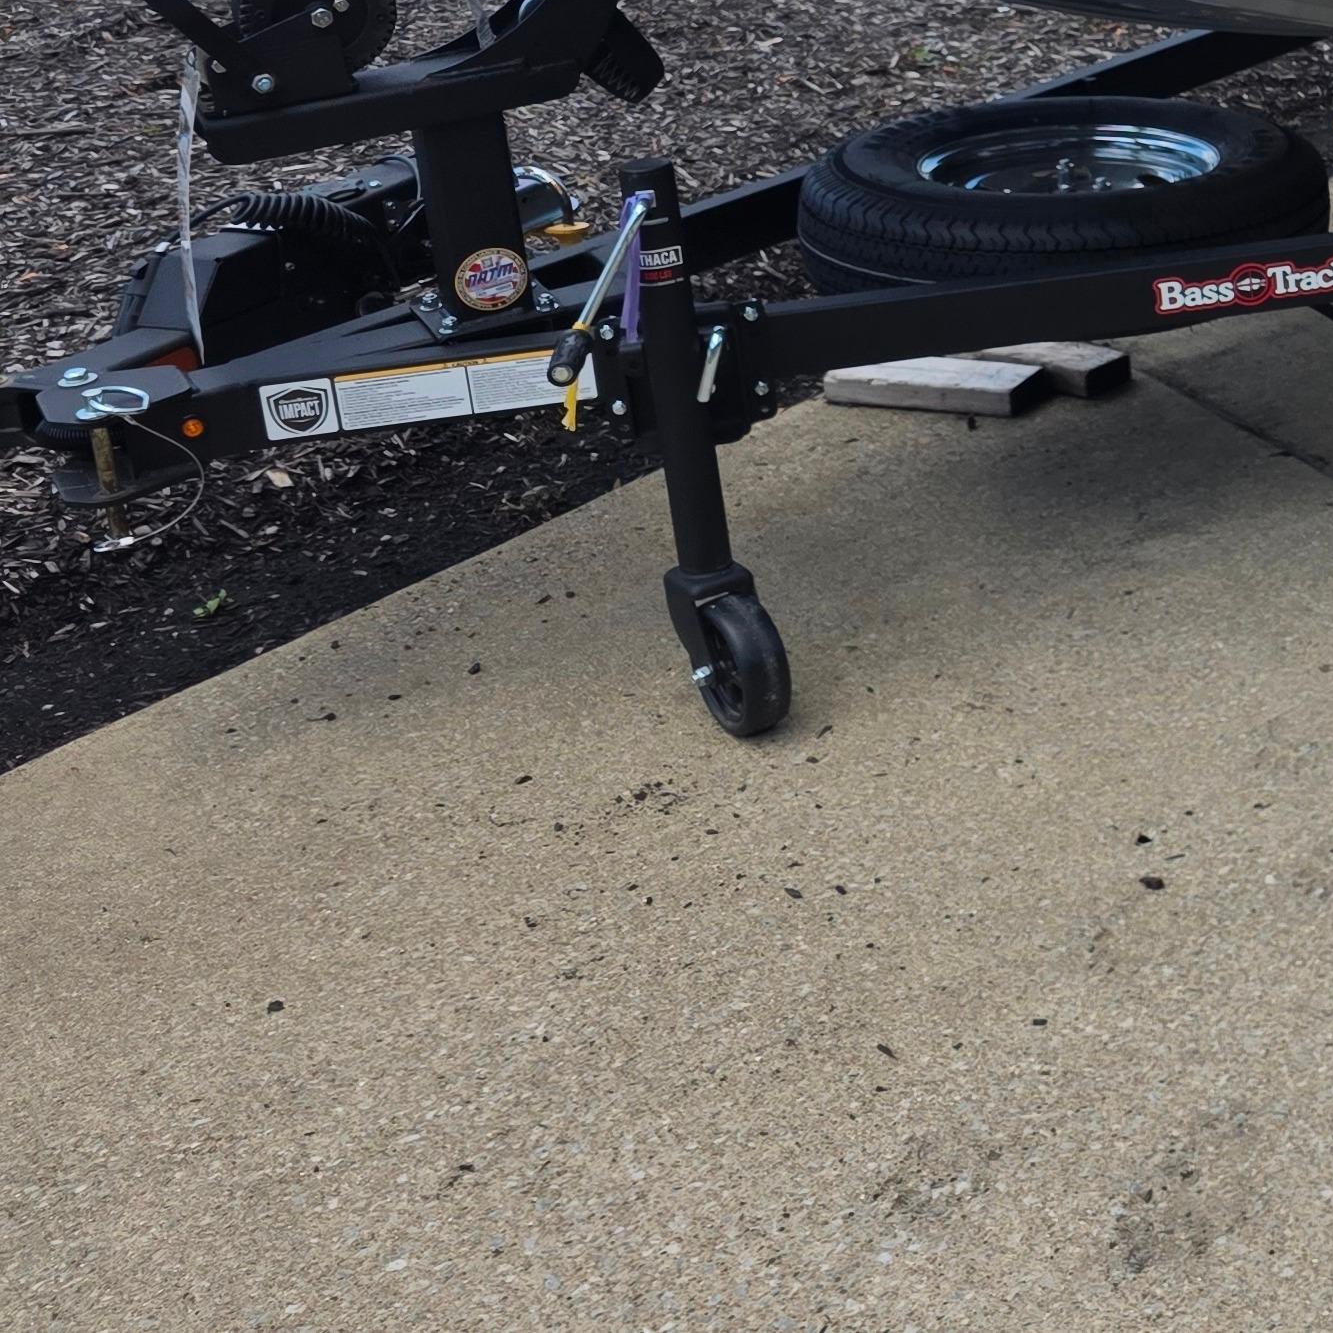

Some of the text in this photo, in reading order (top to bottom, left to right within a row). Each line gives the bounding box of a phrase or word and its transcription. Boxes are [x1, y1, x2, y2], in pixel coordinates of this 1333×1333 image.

[640, 250, 678, 266] THACA
[1158, 281, 1235, 310] Bass
[279, 400, 320, 420] IMPACT
